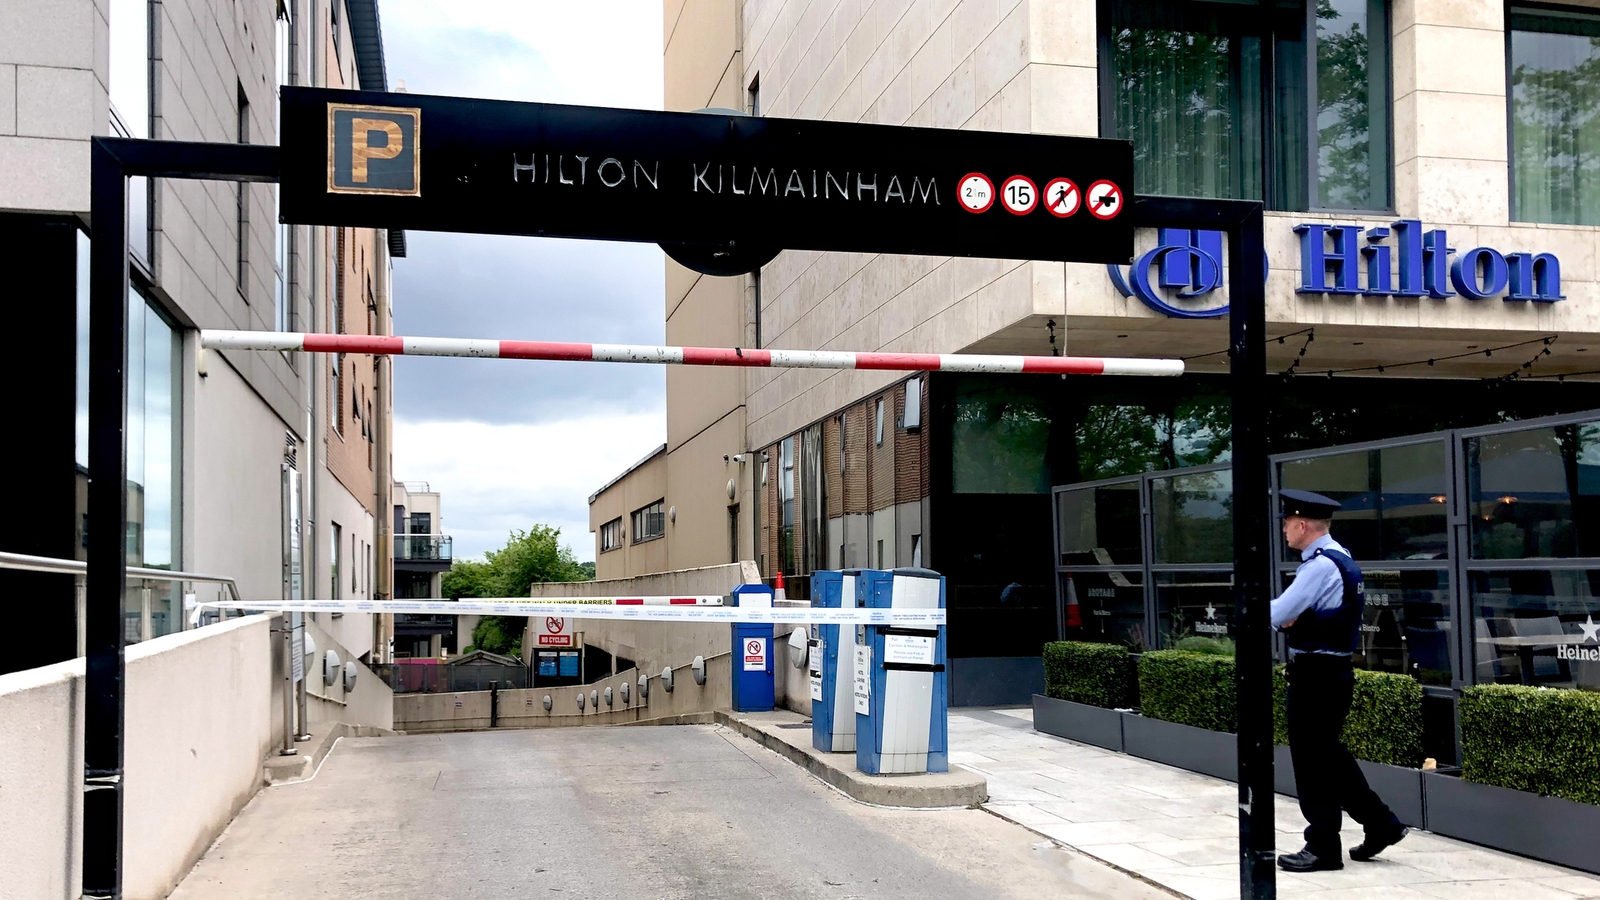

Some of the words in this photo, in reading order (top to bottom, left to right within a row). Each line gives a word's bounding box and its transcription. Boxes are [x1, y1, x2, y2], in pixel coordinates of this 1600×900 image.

[352, 118, 403, 183] P
[513, 152, 658, 190] HILTON
[693, 161, 941, 205] KILMAINHAM
[1008, 185, 1031, 206] 15
[1293, 219, 1567, 303] Hilton
[549, 636, 568, 644] CYCLING
[1362, 623, 1381, 632] Bistro
